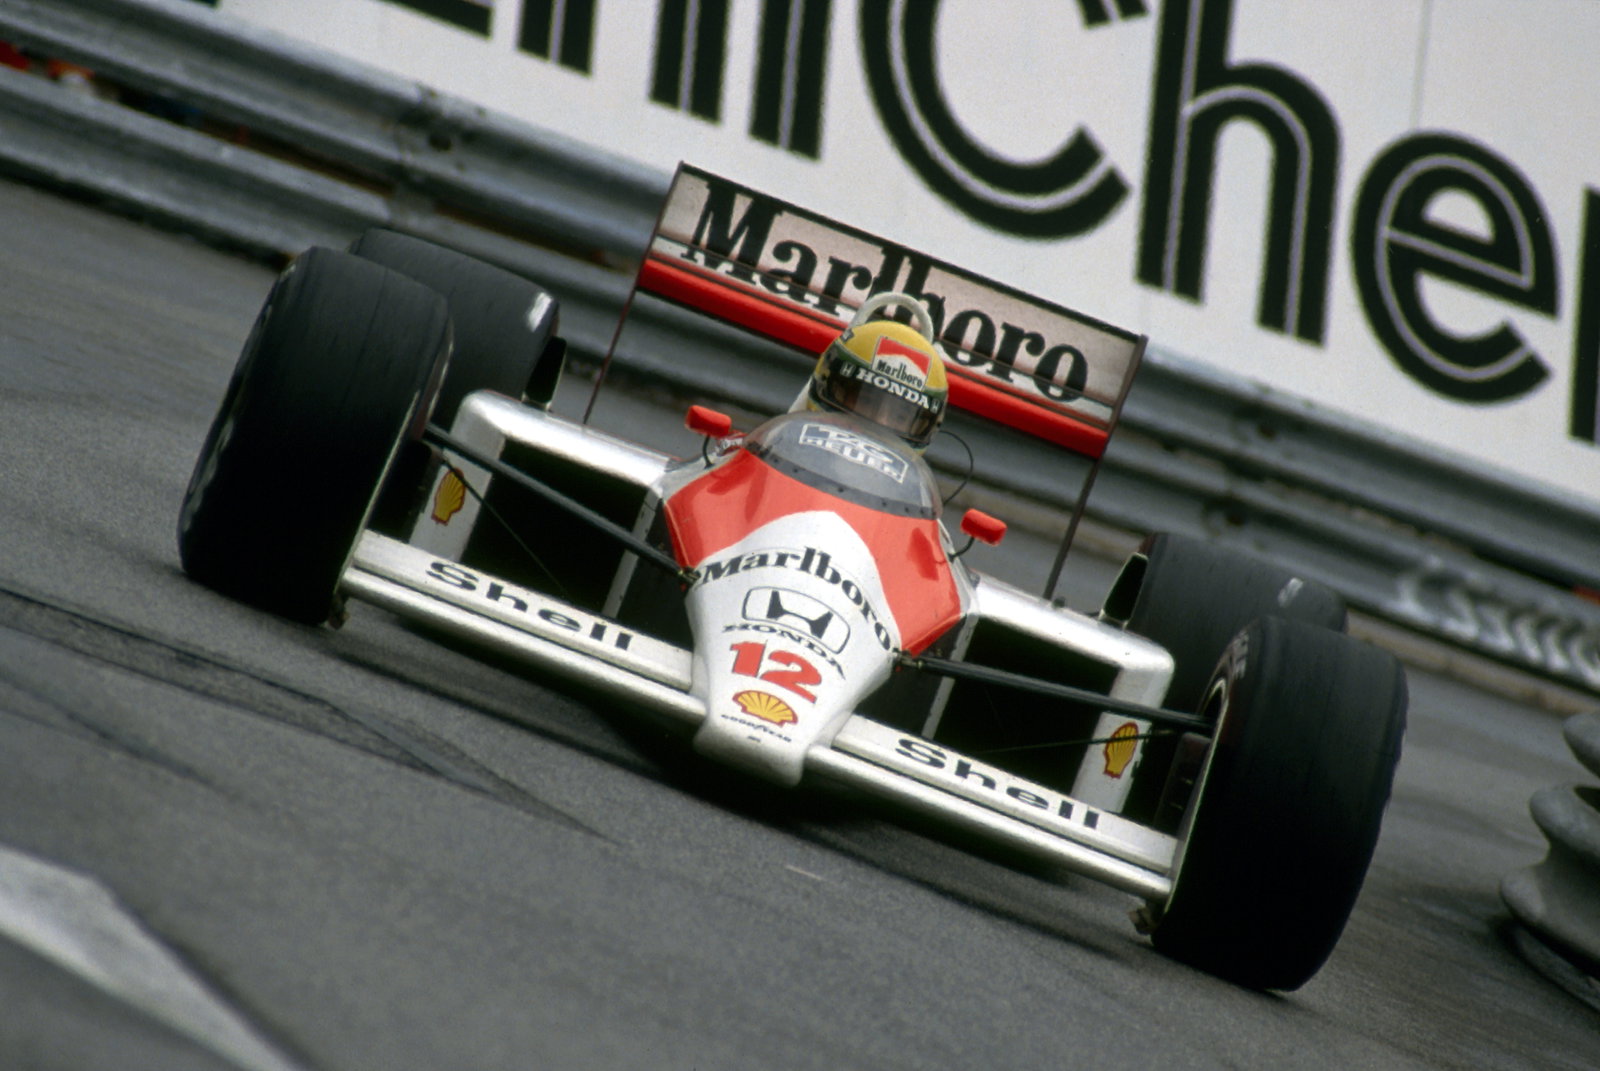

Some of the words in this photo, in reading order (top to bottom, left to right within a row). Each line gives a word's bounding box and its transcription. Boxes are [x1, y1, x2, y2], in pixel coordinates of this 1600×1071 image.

[680, 180, 1089, 403] Marlboro
[856, 367, 930, 410] HONDA
[877, 359, 923, 388] Marlboro
[425, 561, 633, 652] Shell
[699, 545, 892, 651] Marlboro
[722, 623, 847, 681] HONDA
[730, 641, 823, 704] 12
[895, 738, 1100, 830] Shell
